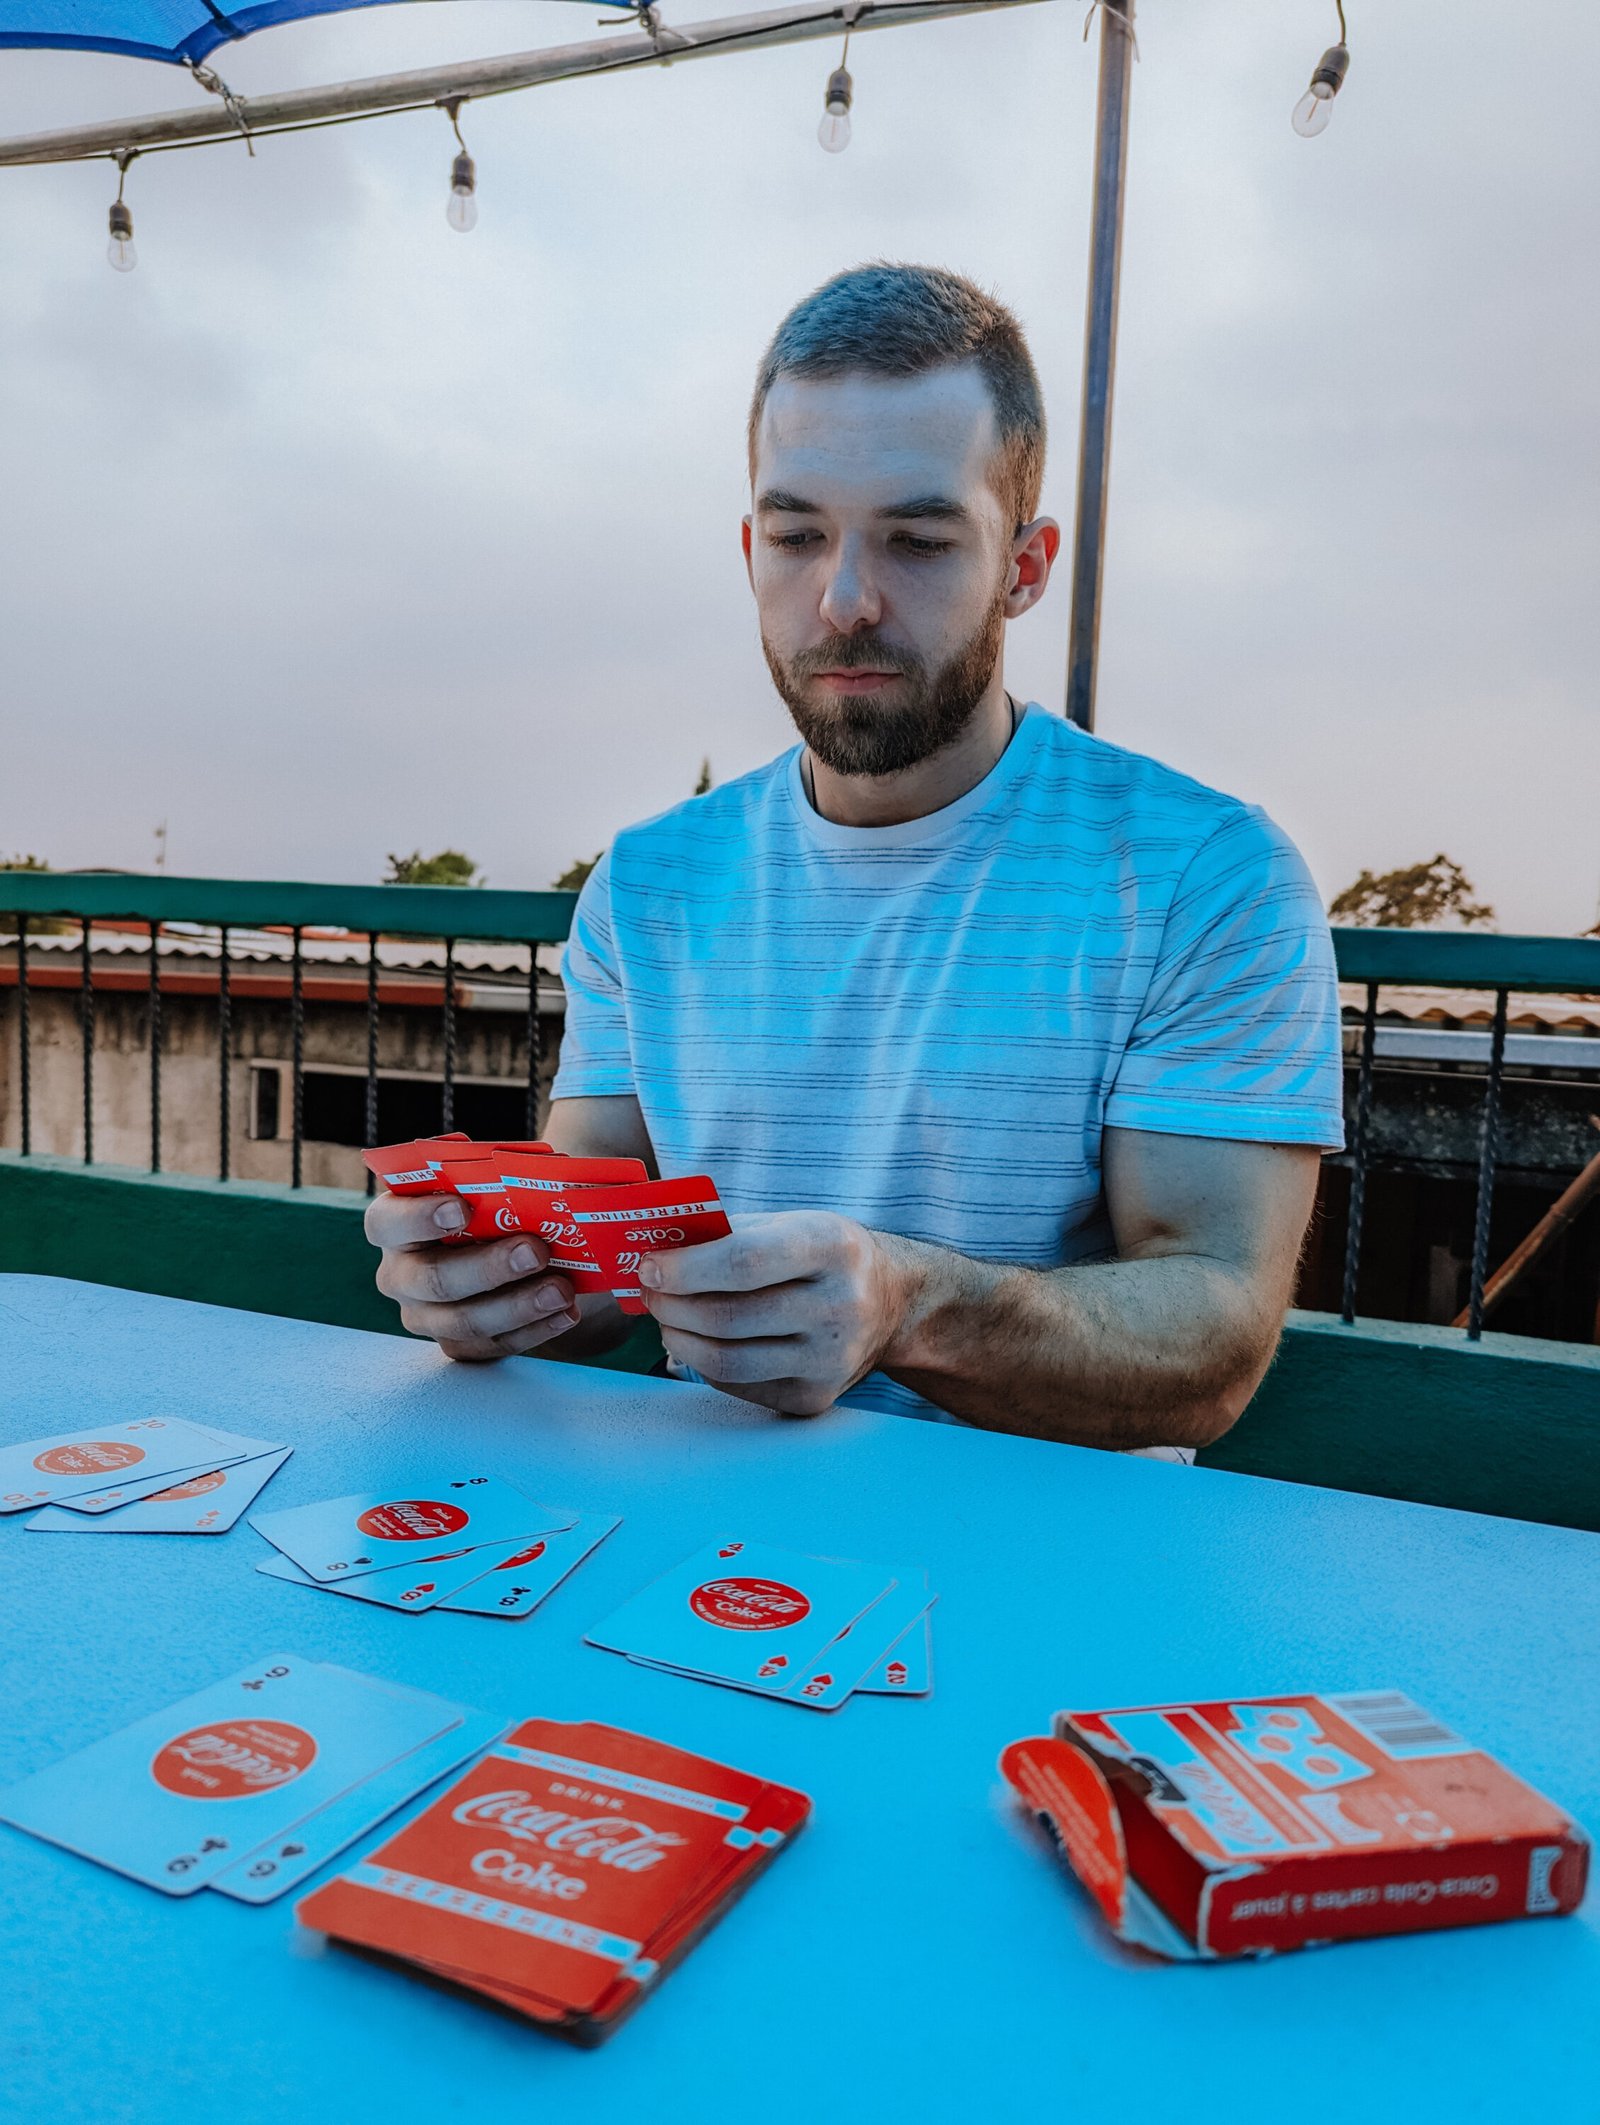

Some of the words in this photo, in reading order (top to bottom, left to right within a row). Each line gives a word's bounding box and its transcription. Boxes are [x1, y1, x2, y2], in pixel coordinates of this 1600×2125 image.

[590, 1203, 708, 1221] REFRESHING
[624, 1227, 686, 1245] Coke
[549, 1258, 592, 1269] REFRESHE
[469, 1477, 488, 1485] 8
[727, 1543, 744, 1552] 4
[326, 1562, 349, 1571] 8
[401, 1591, 422, 1601] 8
[499, 1596, 519, 1606] 8
[701, 1582, 809, 1614] Coca-Cola
[757, 1665, 778, 1677] 4
[887, 1673, 906, 1684] 2
[801, 1684, 825, 1697] 3
[548, 1781, 627, 1812] DRINK
[452, 1789, 689, 1872] Coca-Cola
[470, 1848, 588, 1901] Coke
[1384, 1874, 1498, 1905] Coca-Cola
[1312, 1884, 1380, 1910] cartes
